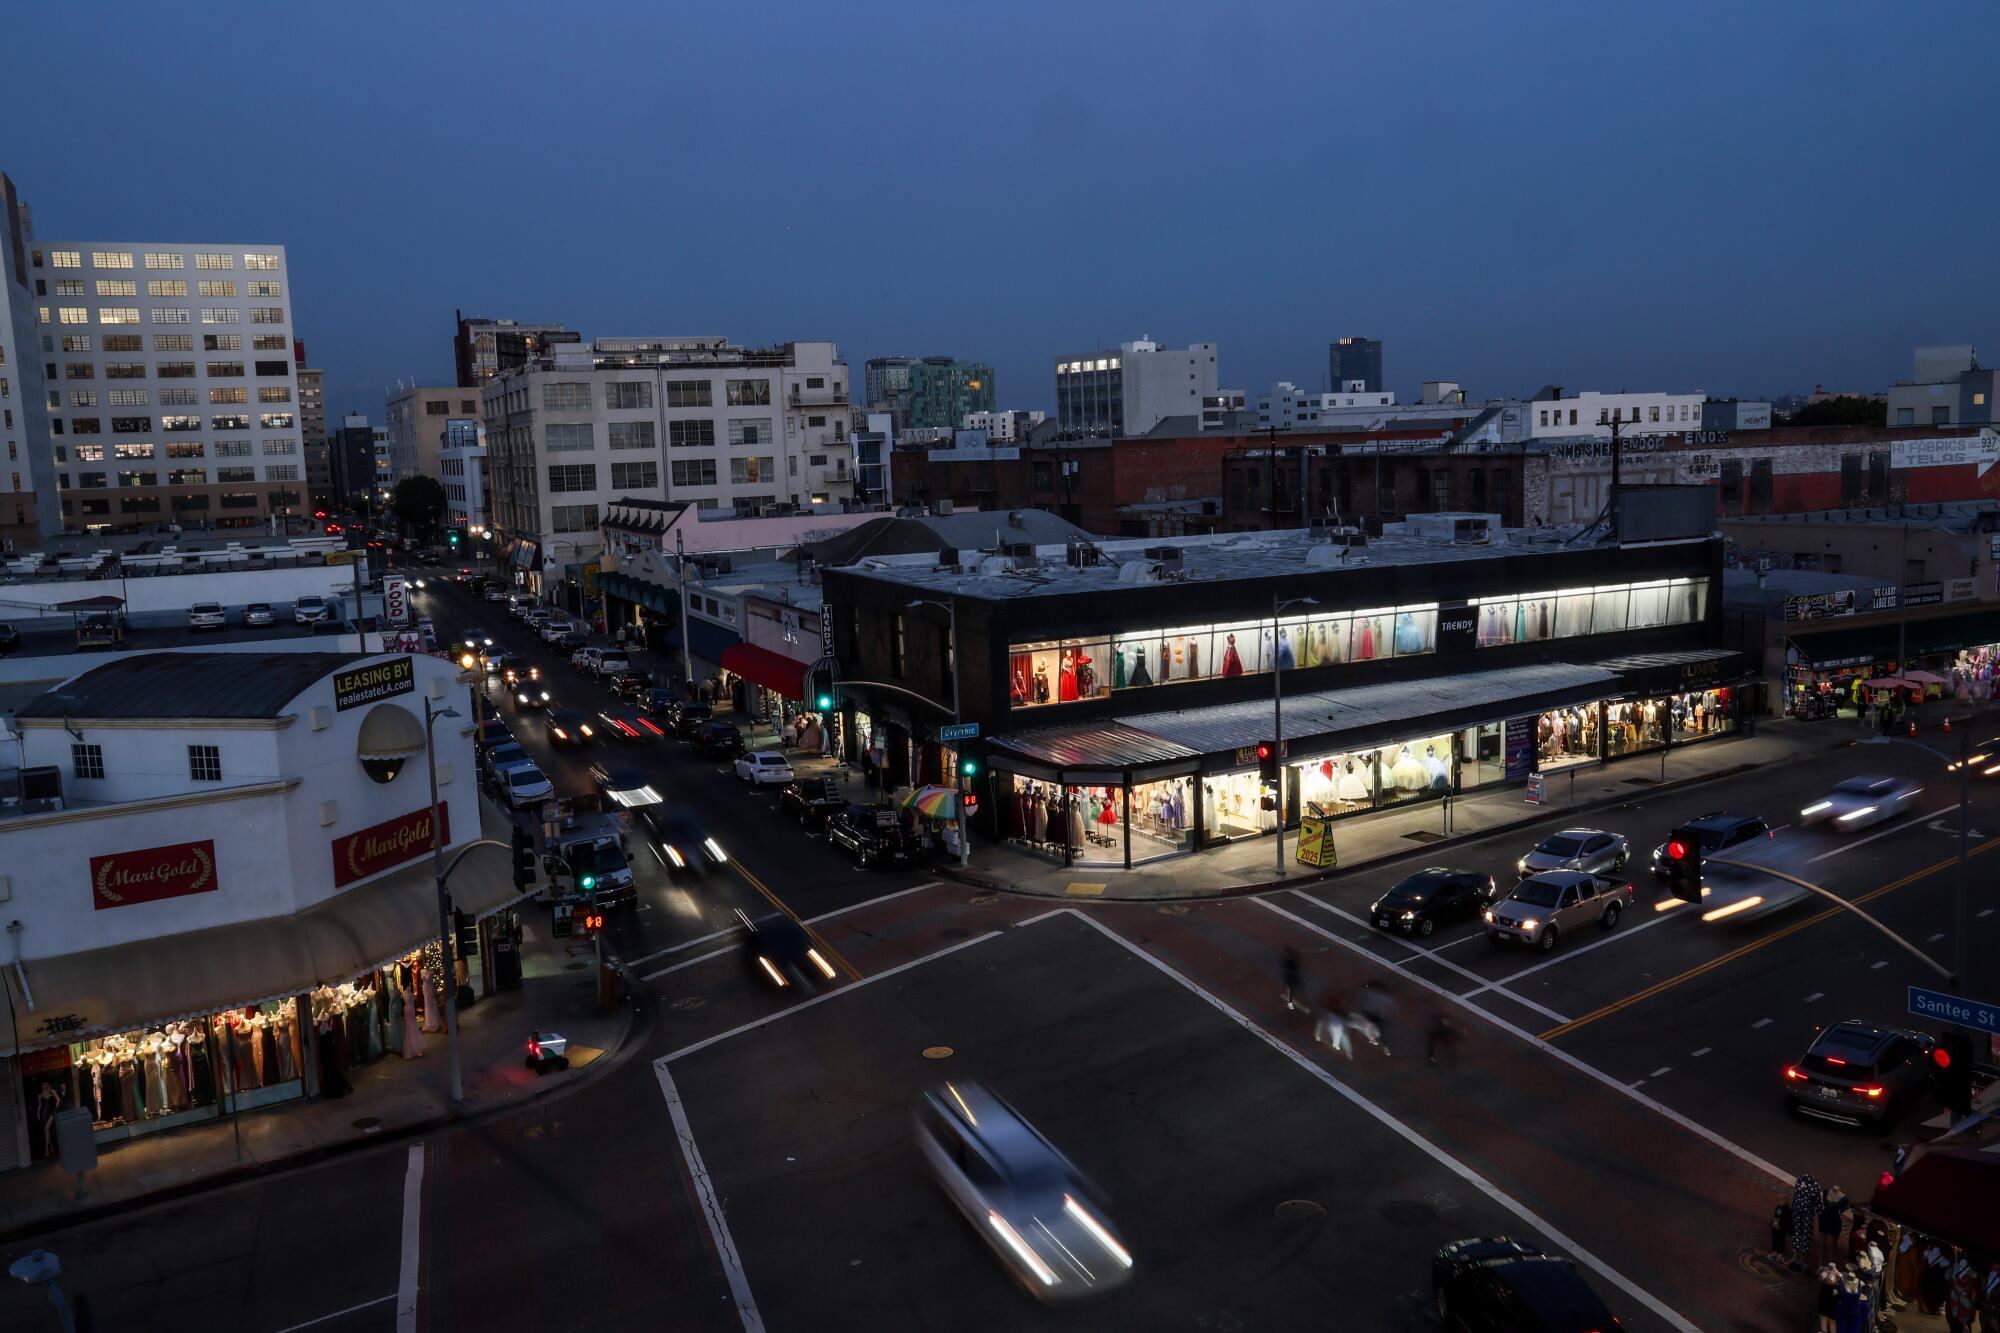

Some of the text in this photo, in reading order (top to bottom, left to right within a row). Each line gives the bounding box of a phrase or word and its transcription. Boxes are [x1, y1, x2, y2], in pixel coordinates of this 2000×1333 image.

[1906, 453, 1966, 465] TELAS
[1909, 440, 1966, 453] FABRICS
[389, 582, 403, 617] FOOD
[822, 606, 832, 645] TRENDY
[1441, 620, 1473, 631] TRENDY
[337, 662, 409, 694] LEASING BY
[340, 679, 412, 707] realestateLA.com
[1300, 848, 1318, 863] 2025
[110, 857, 200, 888] MariGold
[1916, 995, 1996, 1026] Santee St
